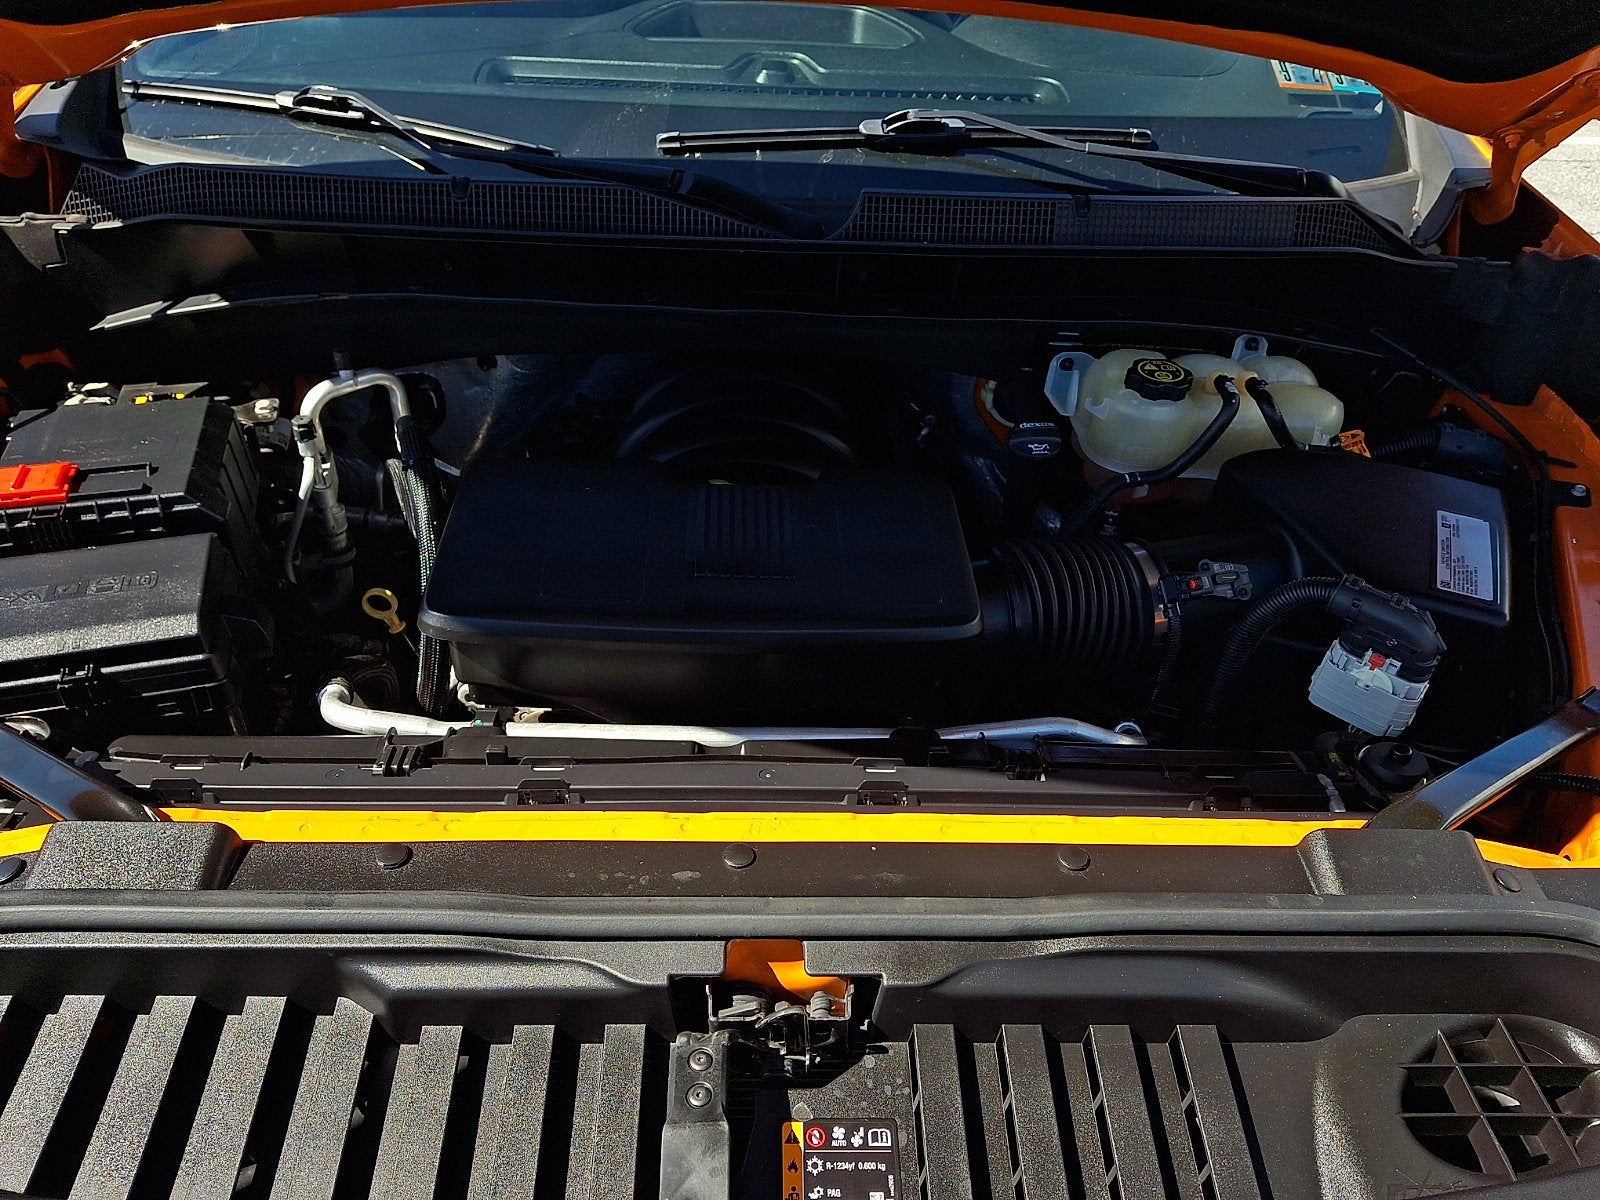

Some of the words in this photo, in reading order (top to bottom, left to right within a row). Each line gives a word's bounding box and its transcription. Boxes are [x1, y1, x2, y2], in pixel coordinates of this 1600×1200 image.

[1019, 421, 1055, 429] dexos
[831, 1139, 847, 1147] AUTO
[826, 1162, 855, 1171] R-1234yf
[858, 1162, 876, 1170] 0.600
[877, 1162, 886, 1171] kg
[827, 1189, 841, 1198] PAG
